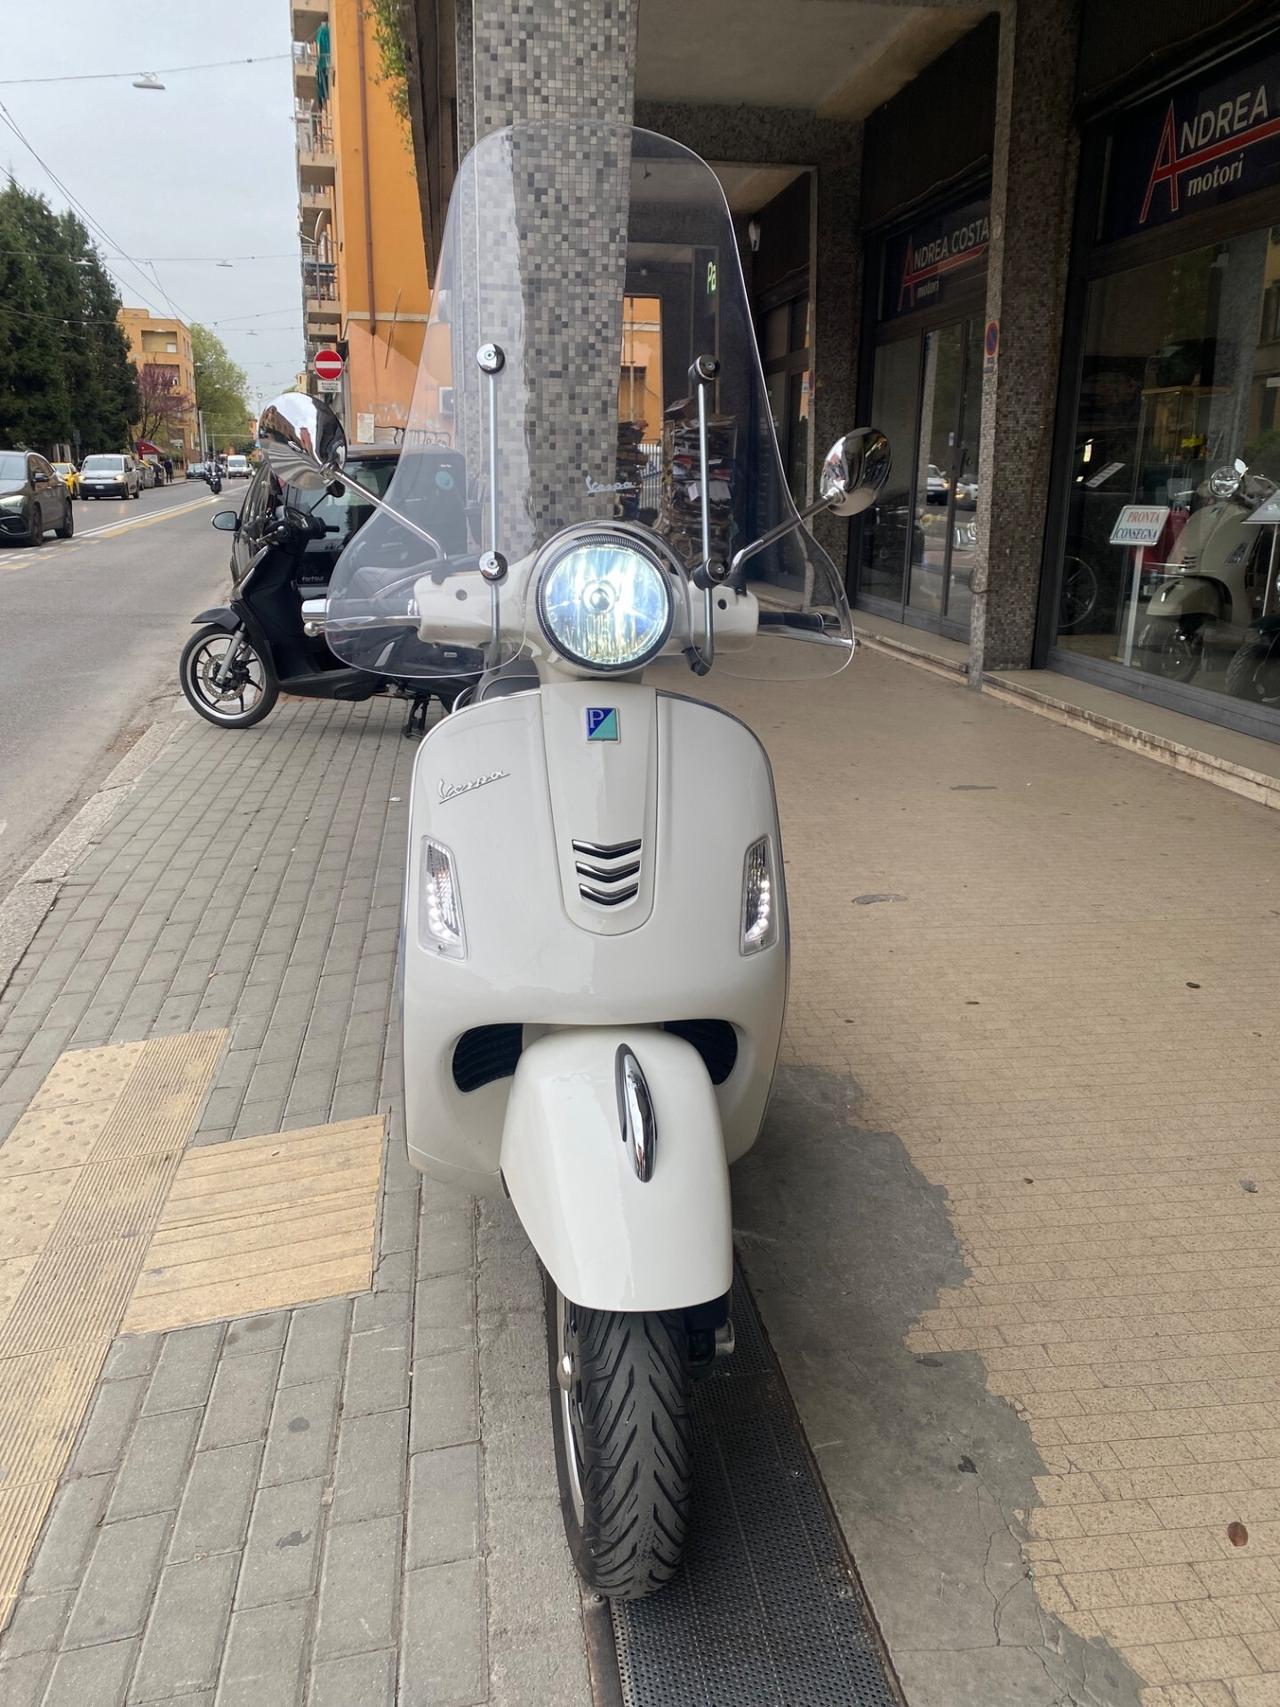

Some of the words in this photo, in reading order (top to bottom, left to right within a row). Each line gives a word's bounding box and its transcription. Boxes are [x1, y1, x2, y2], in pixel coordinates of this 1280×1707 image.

[1138, 84, 1269, 224] ANDREA
[1187, 153, 1245, 198] motori
[898, 234, 949, 311] ANDREA
[951, 217, 990, 253] COSTA
[917, 275, 940, 298] motori
[1127, 511, 1161, 524] PRONTA
[1115, 527, 1158, 540] CONSEGNA
[589, 709, 605, 729] P
[438, 771, 511, 805] Vespa
